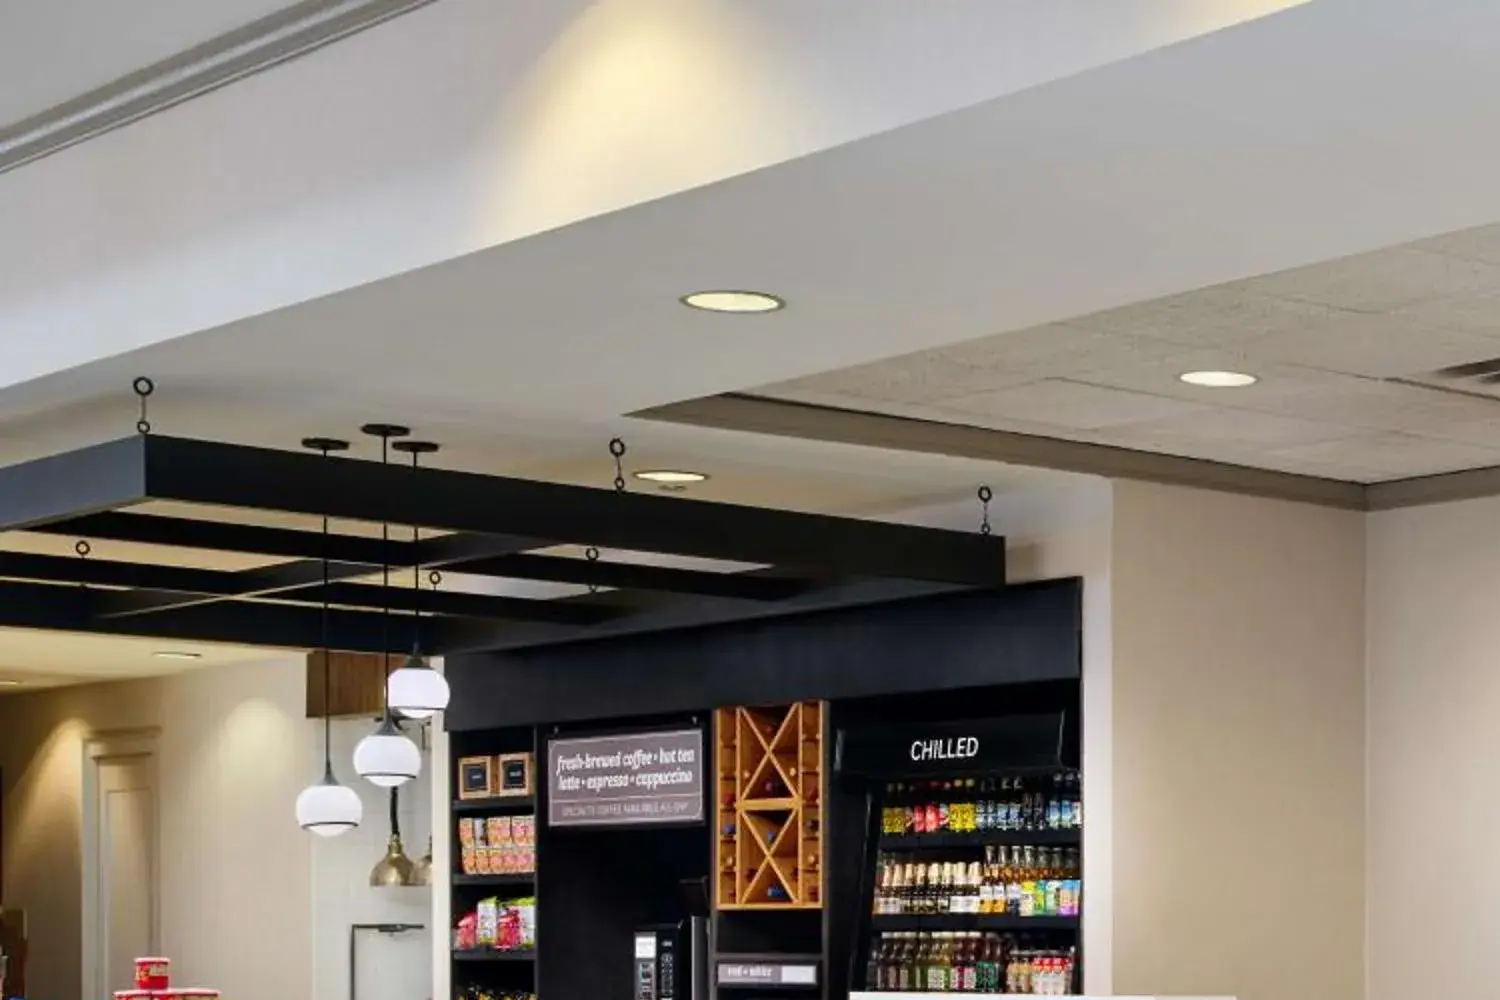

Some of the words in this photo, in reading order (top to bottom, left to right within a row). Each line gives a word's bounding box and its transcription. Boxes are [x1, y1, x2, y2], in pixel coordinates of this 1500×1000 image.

[556, 751, 621, 776] fresh-brewed
[623, 748, 652, 770] coffee
[660, 747, 676, 764] hot
[678, 748, 695, 763] tea
[910, 737, 979, 761] CHILLED
[558, 774, 581, 791] latte
[587, 773, 629, 793] espresso
[636, 767, 693, 791] cappuccino
